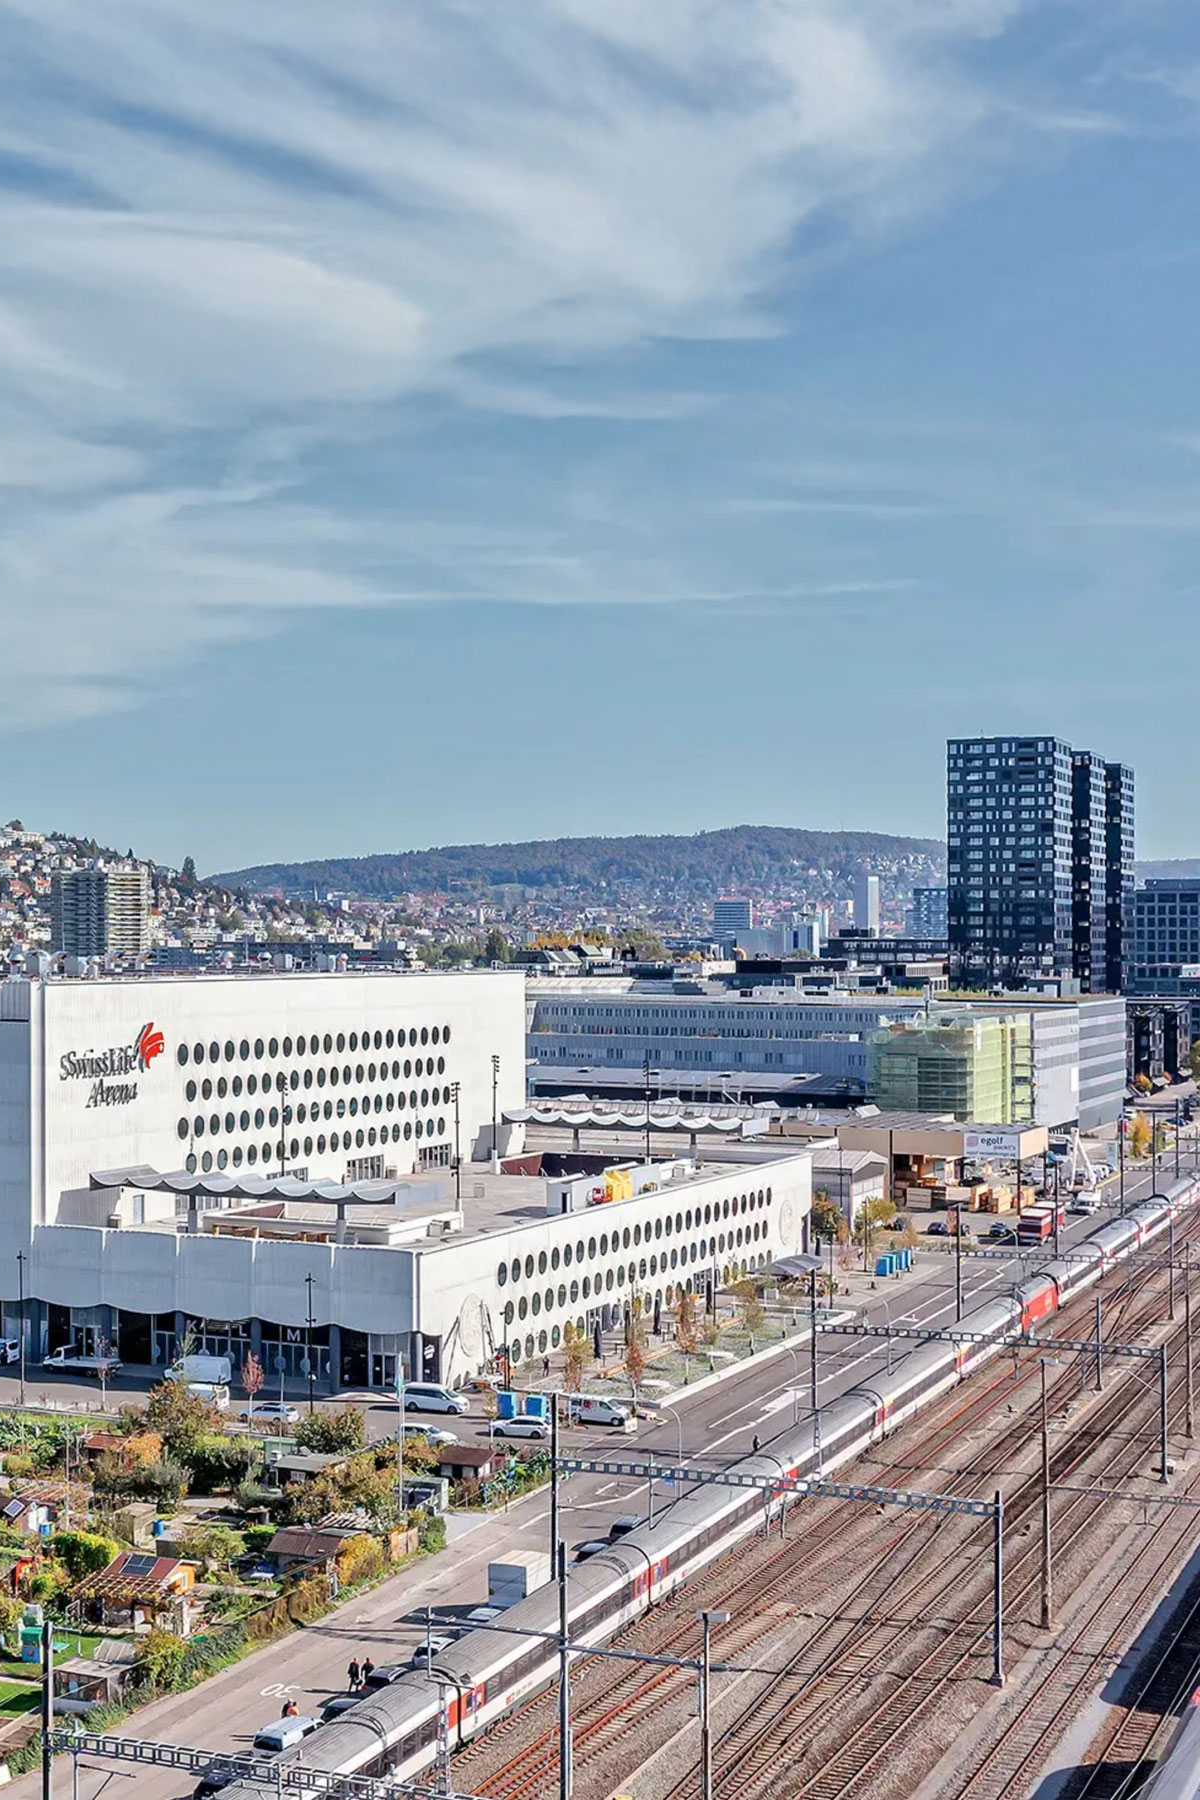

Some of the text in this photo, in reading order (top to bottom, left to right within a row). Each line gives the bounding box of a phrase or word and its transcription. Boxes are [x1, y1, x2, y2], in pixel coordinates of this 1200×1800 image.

[61, 1045, 137, 1079] SwissLife
[87, 1079, 137, 1107] Arena
[980, 1136, 1004, 1146] egolf
[187, 1319, 197, 1332] K
[238, 1324, 247, 1337] L
[286, 1328, 300, 1342] M
